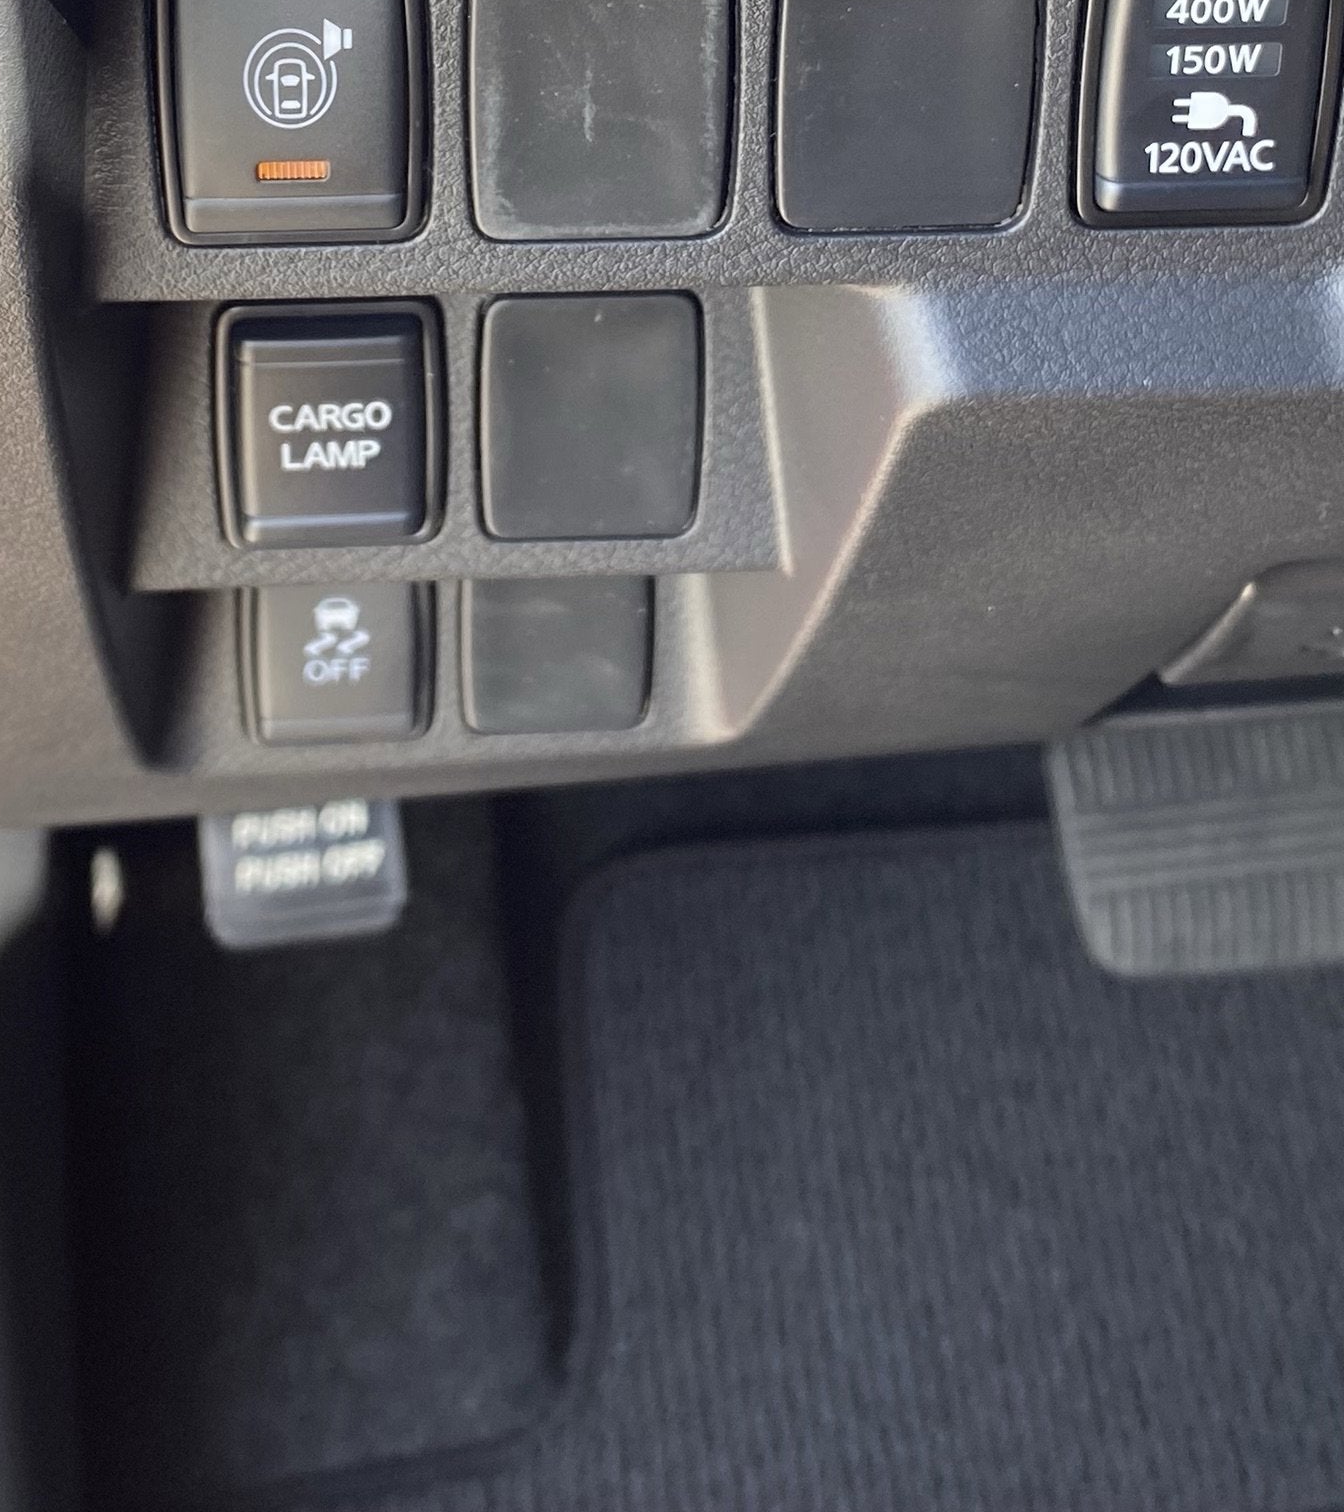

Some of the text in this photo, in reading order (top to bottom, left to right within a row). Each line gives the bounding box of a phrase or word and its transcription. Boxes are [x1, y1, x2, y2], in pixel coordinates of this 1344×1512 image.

[1166, 43, 1262, 75] 150W
[1144, 139, 1276, 174] 120VAC
[268, 400, 393, 433] CARGO
[280, 439, 382, 471] LAMP
[303, 657, 370, 685] OFF
[231, 805, 317, 850] PUSH
[235, 838, 386, 893] PUSH OFF
